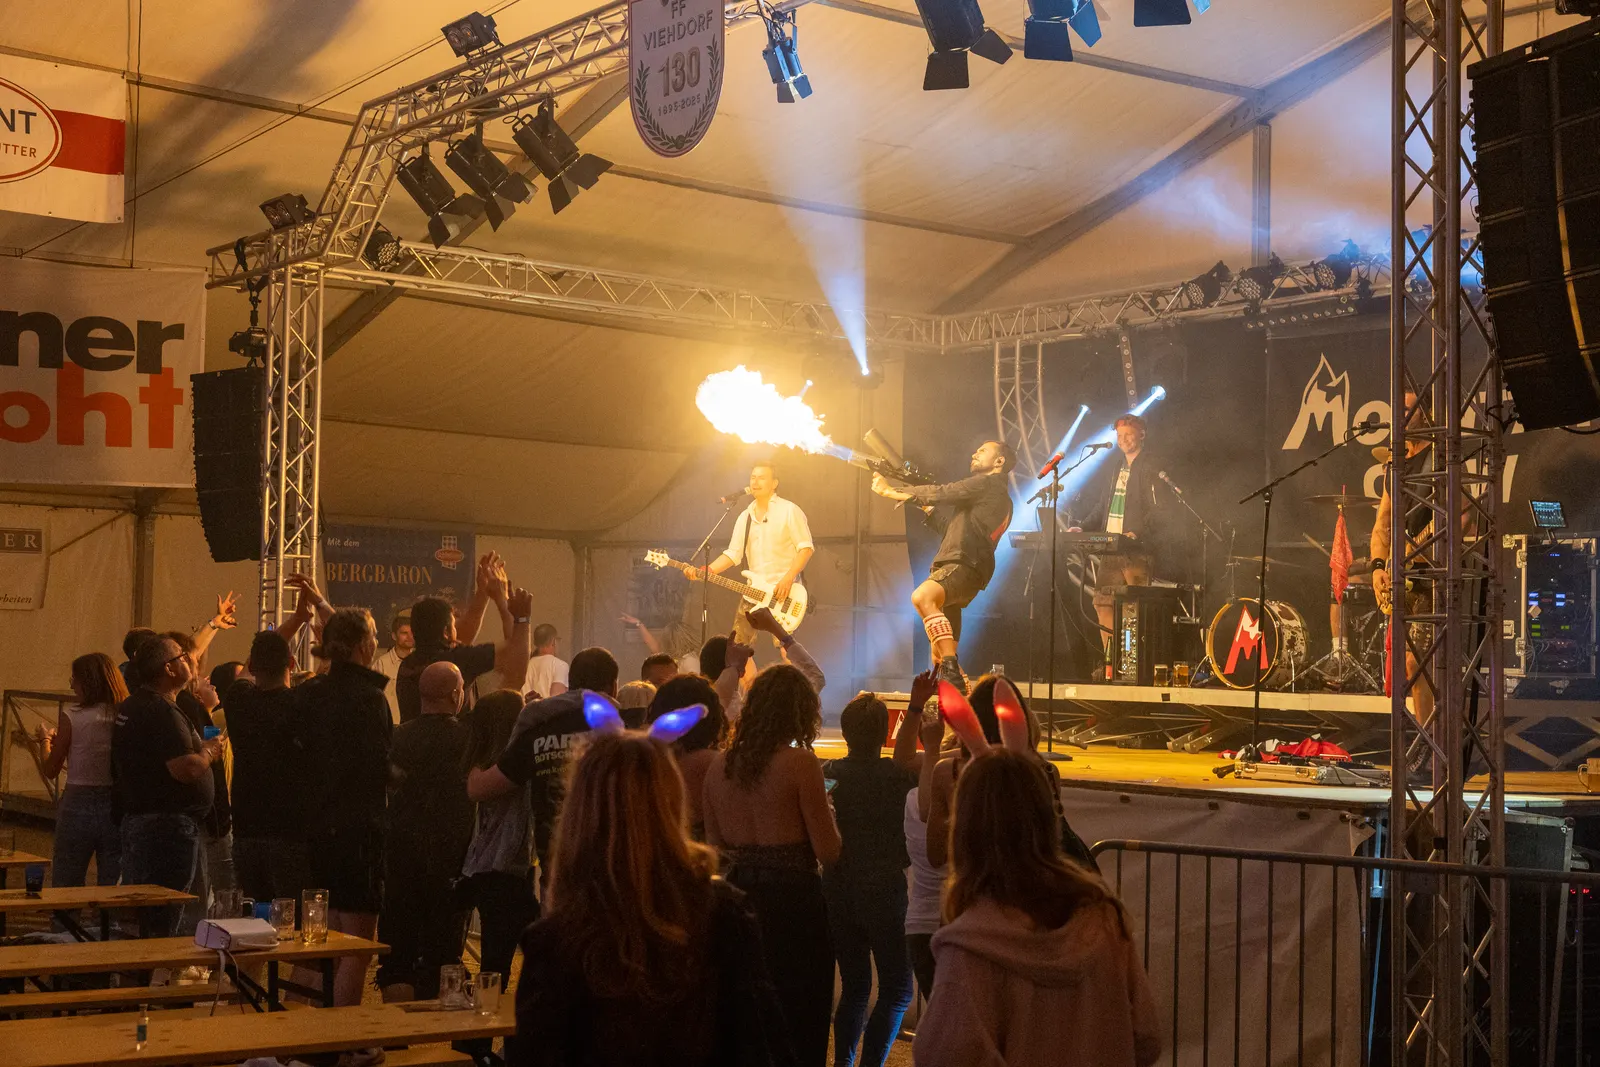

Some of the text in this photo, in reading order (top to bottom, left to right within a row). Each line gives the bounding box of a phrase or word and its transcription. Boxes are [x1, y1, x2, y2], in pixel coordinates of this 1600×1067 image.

[671, 0, 686, 19] FF
[643, 9, 713, 51] VIEHDORF
[658, 46, 701, 97] 130
[657, 94, 702, 117] 1895-2025
[0, 142, 37, 158] TTER
[327, 537, 360, 548] Mit dem
[326, 562, 433, 585] BERGBARON
